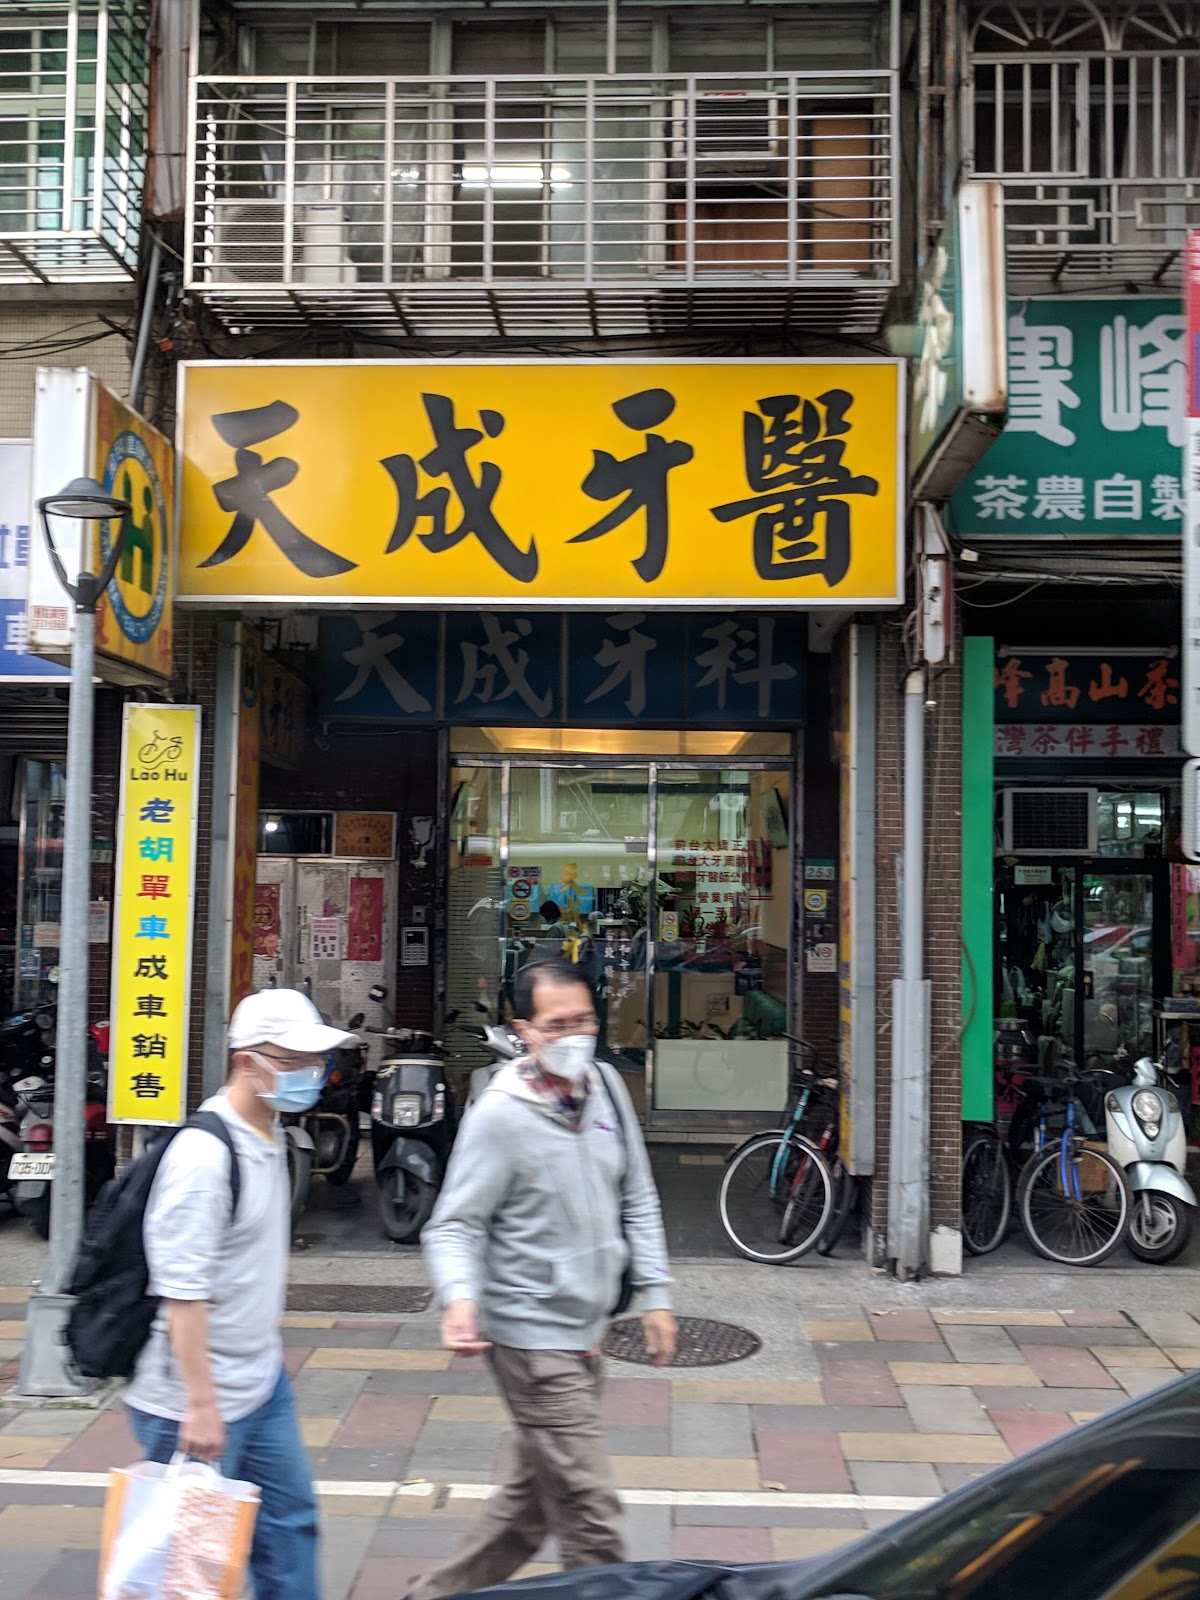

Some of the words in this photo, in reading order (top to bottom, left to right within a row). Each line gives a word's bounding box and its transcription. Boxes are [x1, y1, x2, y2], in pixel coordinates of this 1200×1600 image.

[196, 388, 879, 588] 天成牙醫
[972, 473, 1185, 521] 茶農自製
[335, 611, 798, 718] 天成牙科
[996, 726, 1165, 756] 灣茶伴手禮
[130, 768, 160, 782] Lao
[164, 769, 188, 782] Hu
[806, 867, 834, 878] 253
[129, 797, 176, 1099] 老胡單車成車銷售
